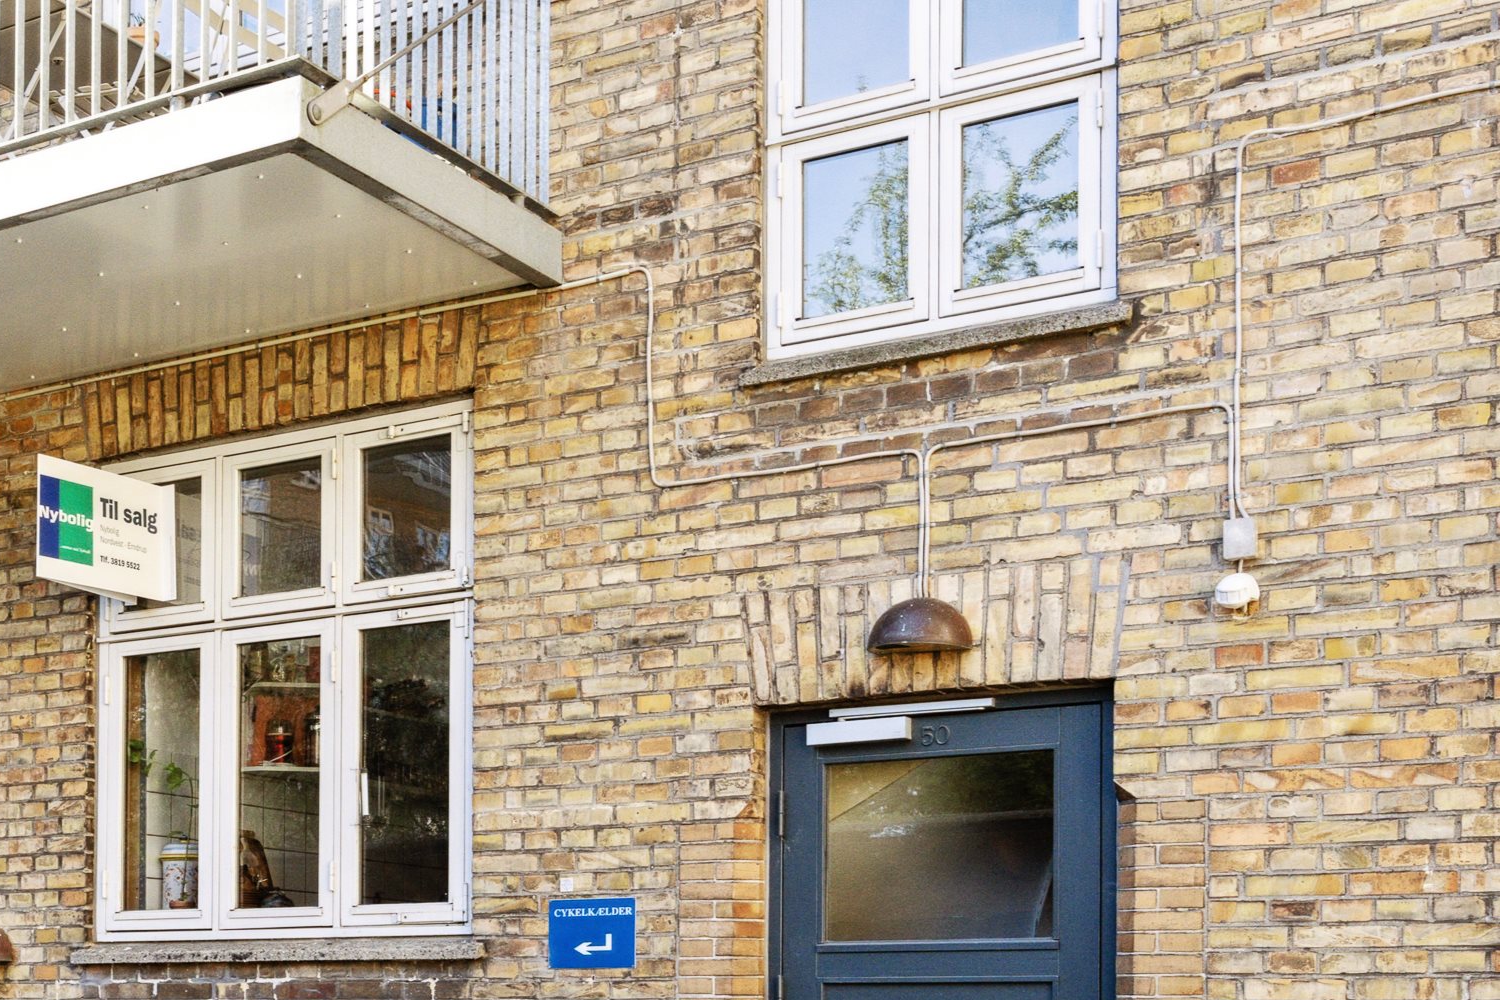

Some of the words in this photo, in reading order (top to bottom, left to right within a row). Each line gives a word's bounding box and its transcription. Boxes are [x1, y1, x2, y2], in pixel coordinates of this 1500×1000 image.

[39, 505, 93, 532] Nybolig
[100, 497, 118, 520] Til
[124, 508, 157, 534] salg
[110, 557, 125, 567] 3819
[126, 561, 141, 571] 5522
[921, 725, 951, 745] 50
[554, 906, 633, 917] CYKELKÆLDER
